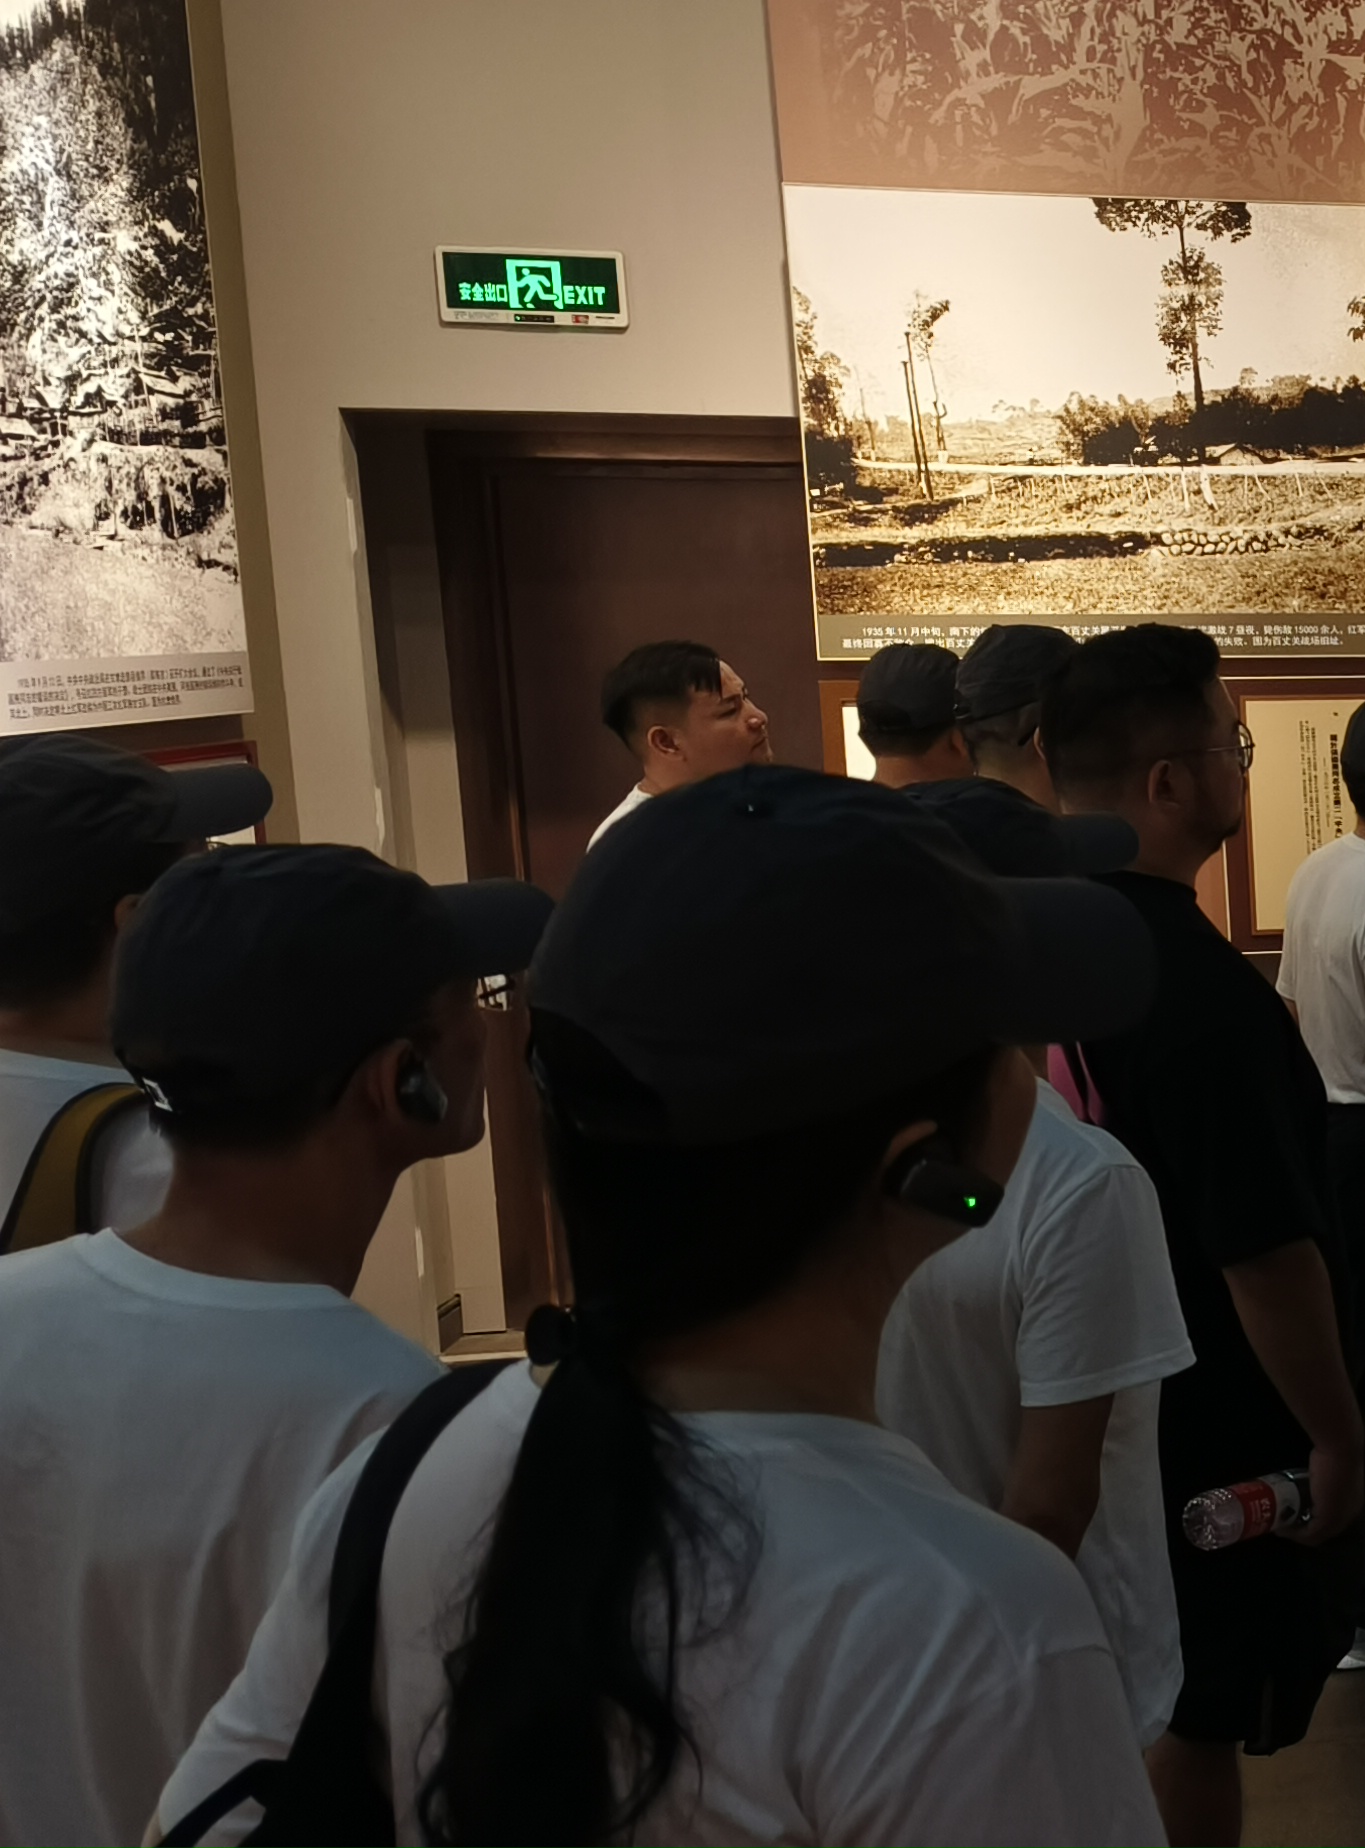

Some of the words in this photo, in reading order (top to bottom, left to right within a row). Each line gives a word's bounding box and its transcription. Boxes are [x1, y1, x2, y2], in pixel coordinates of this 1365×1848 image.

[458, 282, 508, 303] 安全出口
[563, 285, 606, 305] EXIT
